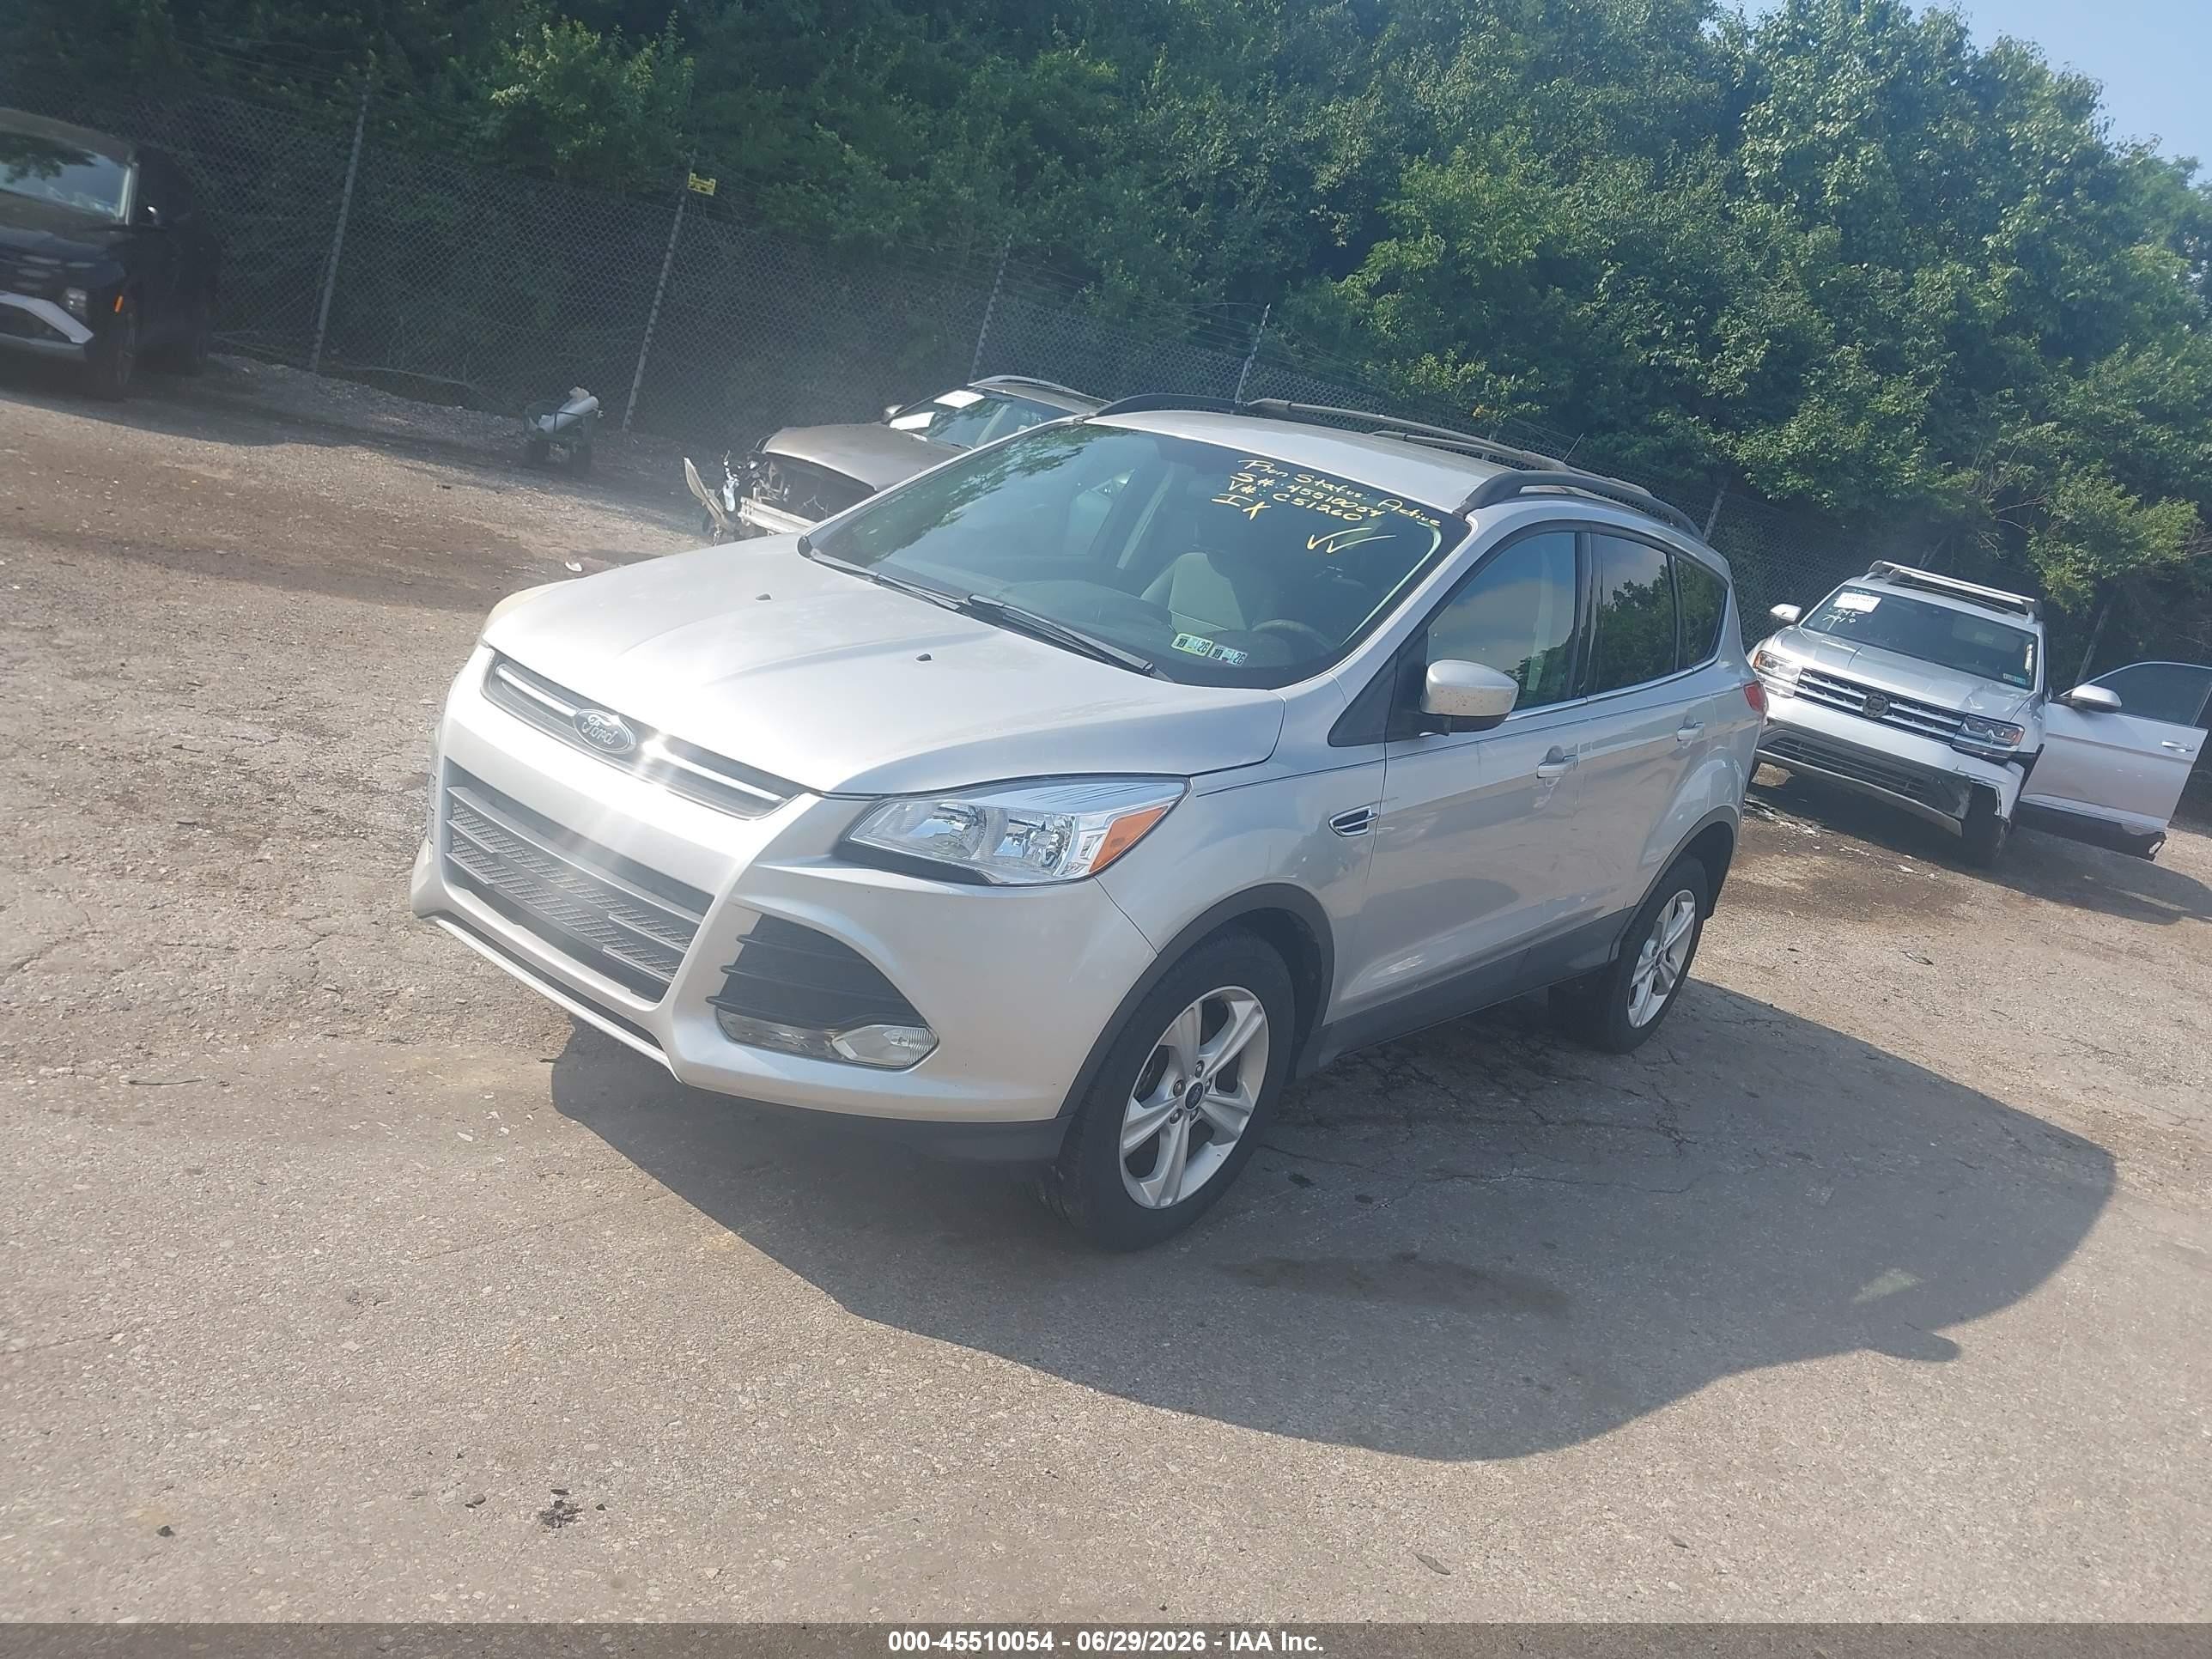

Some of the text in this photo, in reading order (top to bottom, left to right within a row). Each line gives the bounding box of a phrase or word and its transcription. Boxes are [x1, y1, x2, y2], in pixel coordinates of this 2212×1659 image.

[1237, 459, 1289, 477] Run
[1377, 498, 1442, 527] Active
[1272, 493, 1363, 520] C51260
[1287, 484, 1385, 517] 45510054
[1197, 641, 1210, 653] 26
[1232, 653, 1246, 665] 26
[580, 714, 619, 744] Ford
